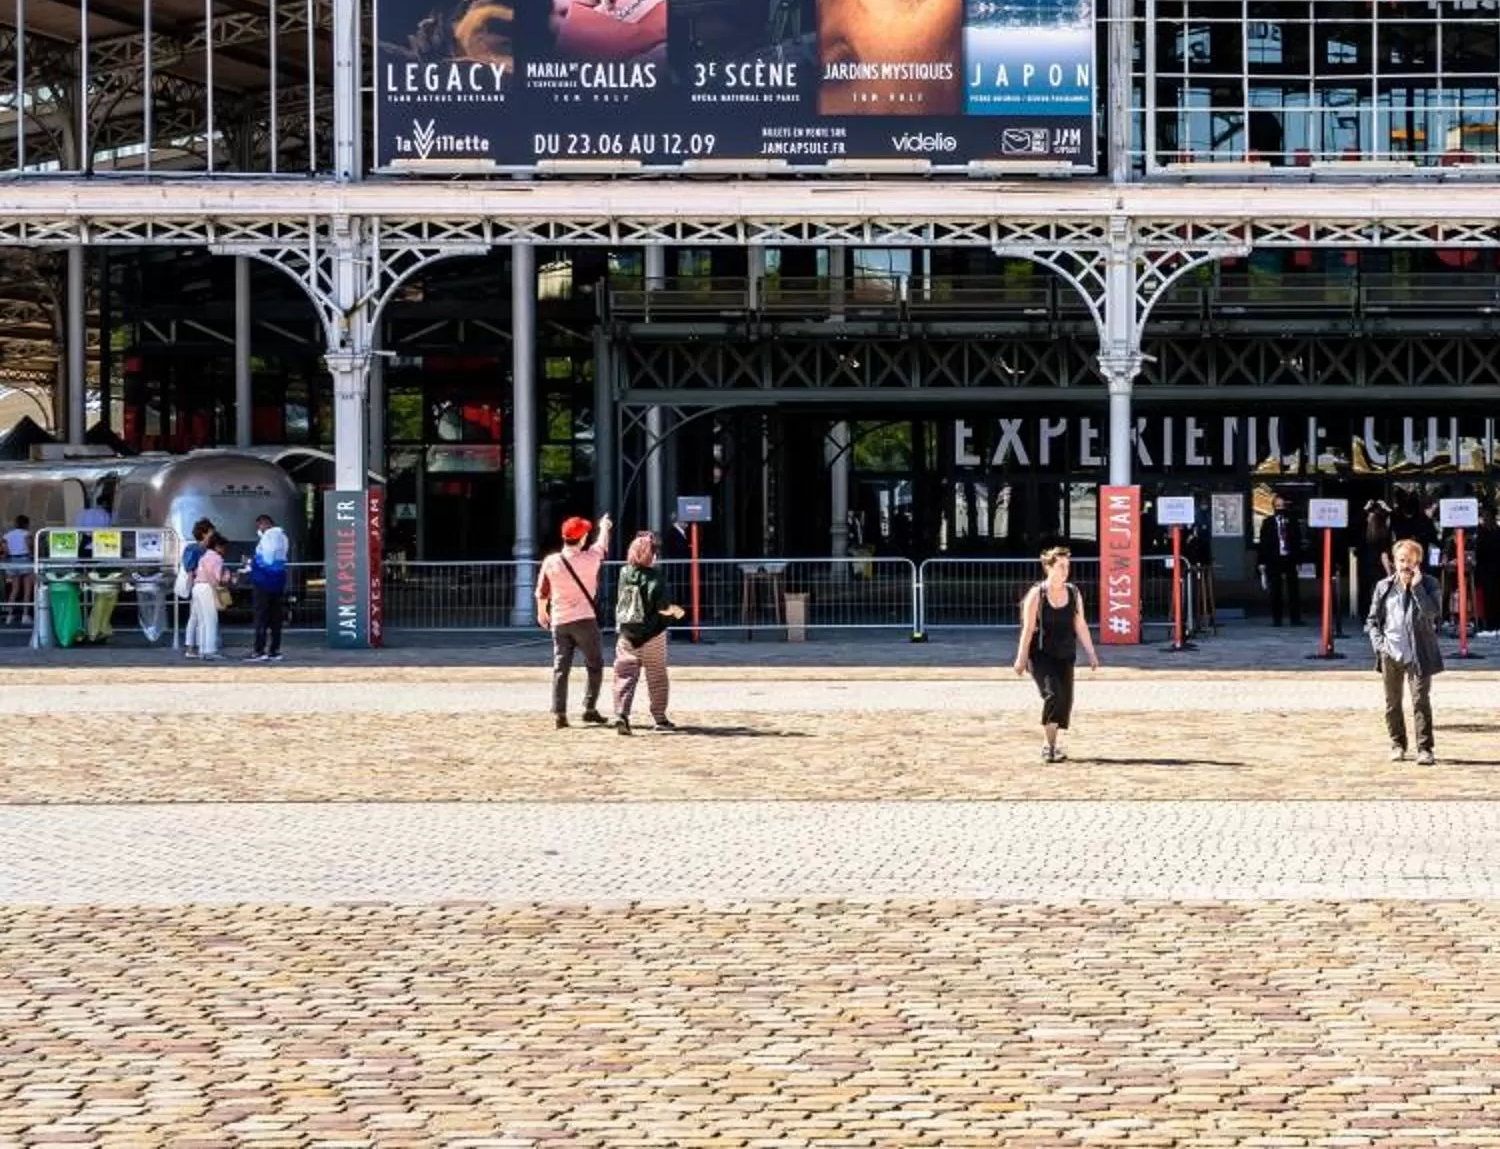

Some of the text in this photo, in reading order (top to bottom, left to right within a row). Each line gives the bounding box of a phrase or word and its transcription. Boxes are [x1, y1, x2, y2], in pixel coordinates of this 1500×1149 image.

[386, 63, 505, 92] LEGACY
[527, 62, 568, 78] MARIA
[580, 62, 657, 89] CALLAS
[725, 59, 797, 87] SCÈNE
[823, 62, 954, 80] JARDINS MYSTIQUES
[969, 63, 1090, 87] JAPON
[534, 133, 716, 155] DU 23.06 AU 12.09
[760, 141, 847, 154] JAMCAPSULE.FR
[336, 499, 358, 640] JAMCAPSULE.FR
[1107, 494, 1132, 636] #YESWEJAM
